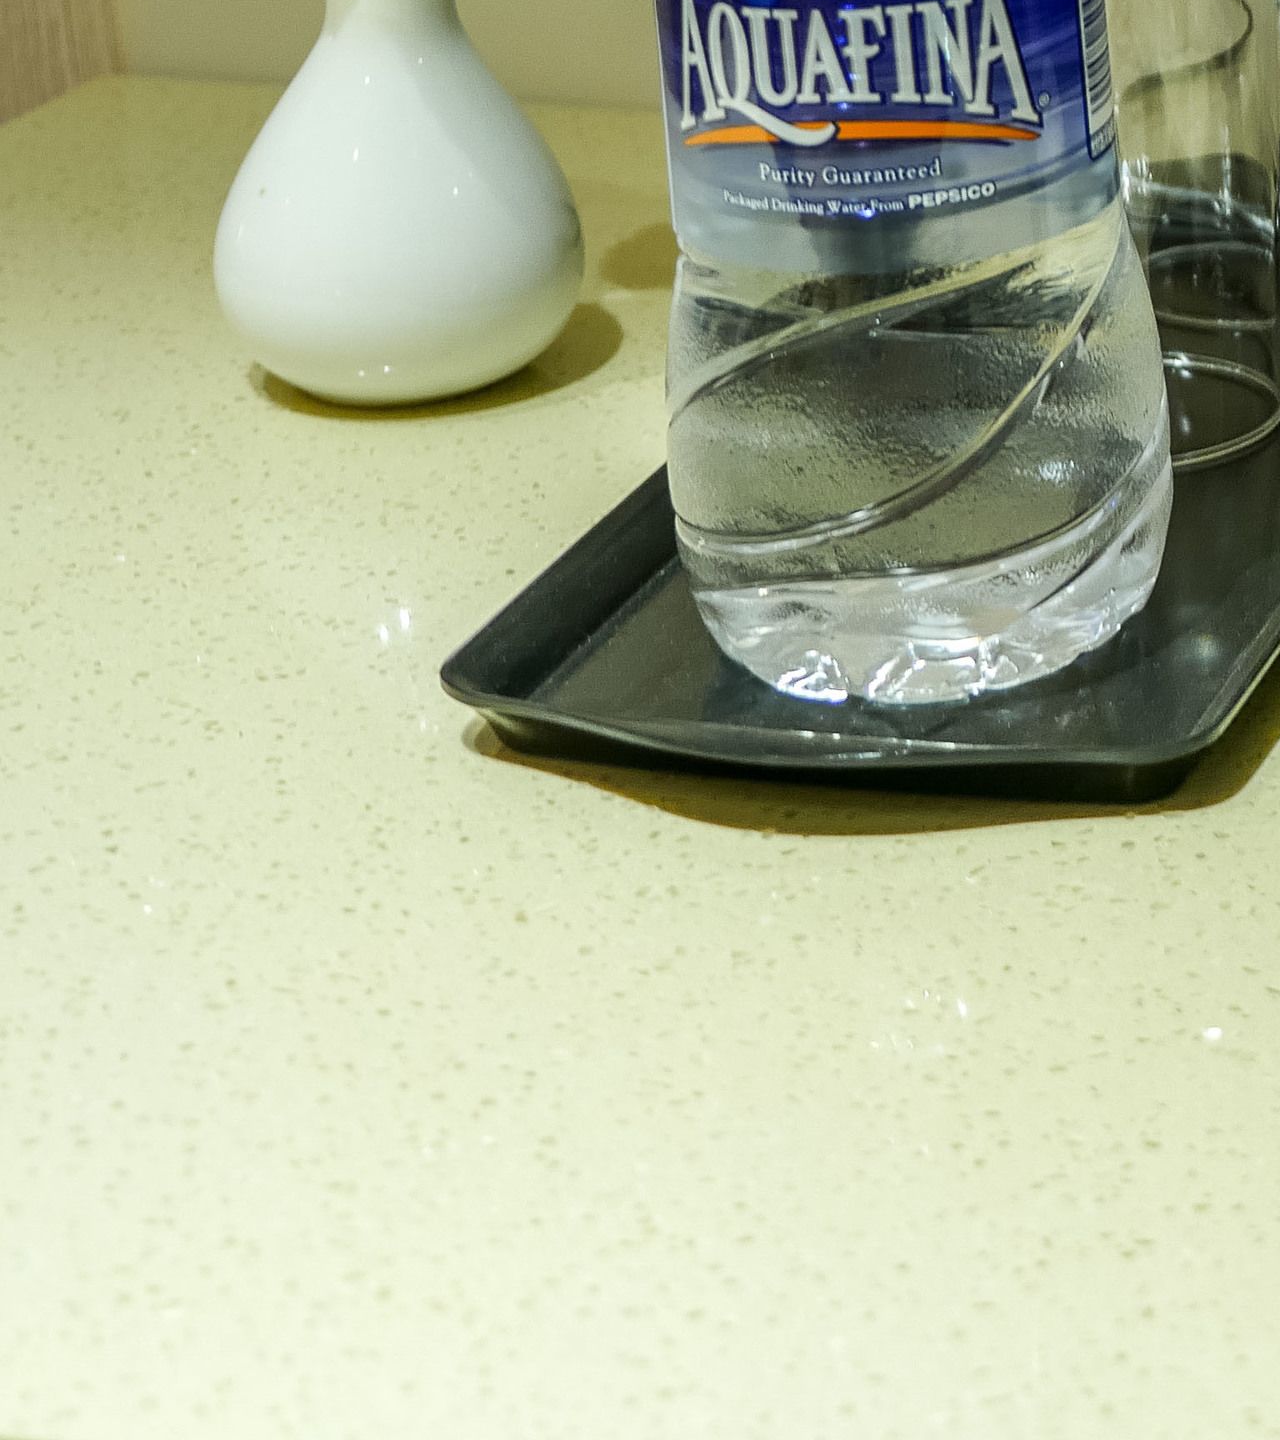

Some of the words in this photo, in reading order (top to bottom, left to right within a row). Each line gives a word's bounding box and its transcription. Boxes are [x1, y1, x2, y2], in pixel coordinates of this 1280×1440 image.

[758, 162, 815, 188] Purity
[822, 157, 942, 186] Guaranteed
[723, 188, 769, 211] Packaged
[771, 196, 825, 216] Drinking
[826, 199, 865, 214] Water
[871, 199, 905, 212] From
[907, 181, 997, 210] PEPSICO
